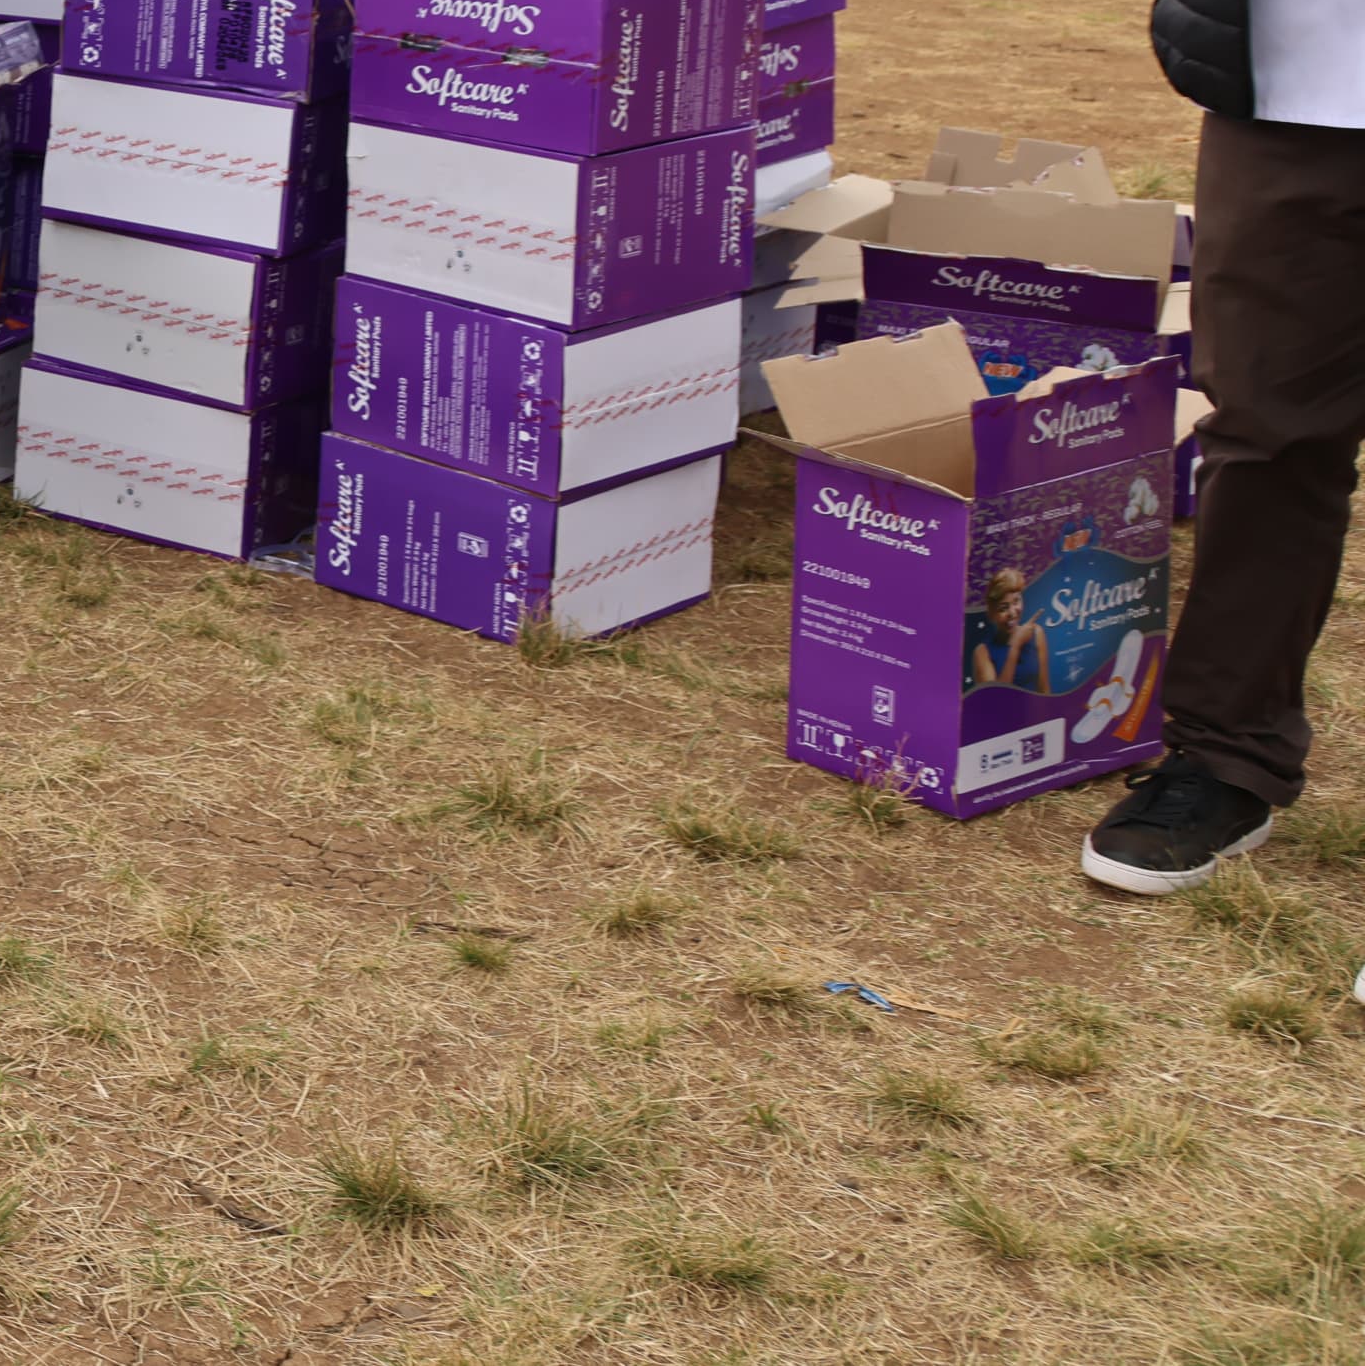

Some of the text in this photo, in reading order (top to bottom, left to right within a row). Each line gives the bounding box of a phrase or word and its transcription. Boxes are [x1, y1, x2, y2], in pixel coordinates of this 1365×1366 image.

[254, 5, 268, 69] Sanitary Pads
[405, 65, 515, 106] Softcare
[610, 21, 635, 132] Softcare
[450, 102, 519, 122] Sanitary Pads
[726, 150, 749, 256] Softcare
[931, 266, 1065, 297] Softcare
[989, 293, 1072, 312] Sanitary Pads
[371, 316, 383, 379] Sanitary Pads
[877, 324, 907, 334] MAXI
[967, 336, 1011, 348] GULAR
[347, 317, 377, 421] Softcare
[983, 361, 1023, 378] NEW
[1028, 401, 1120, 447] Softcare
[1068, 427, 1125, 449] Sanitary Pads
[329, 474, 357, 576] Softcare
[353, 473, 364, 535] Sanitary Pads
[812, 487, 926, 538] Softcare
[859, 528, 931, 556] Sanitary Pads
[1045, 577, 1147, 630] Softcare
[1089, 605, 1151, 631] Sanitary Pads
